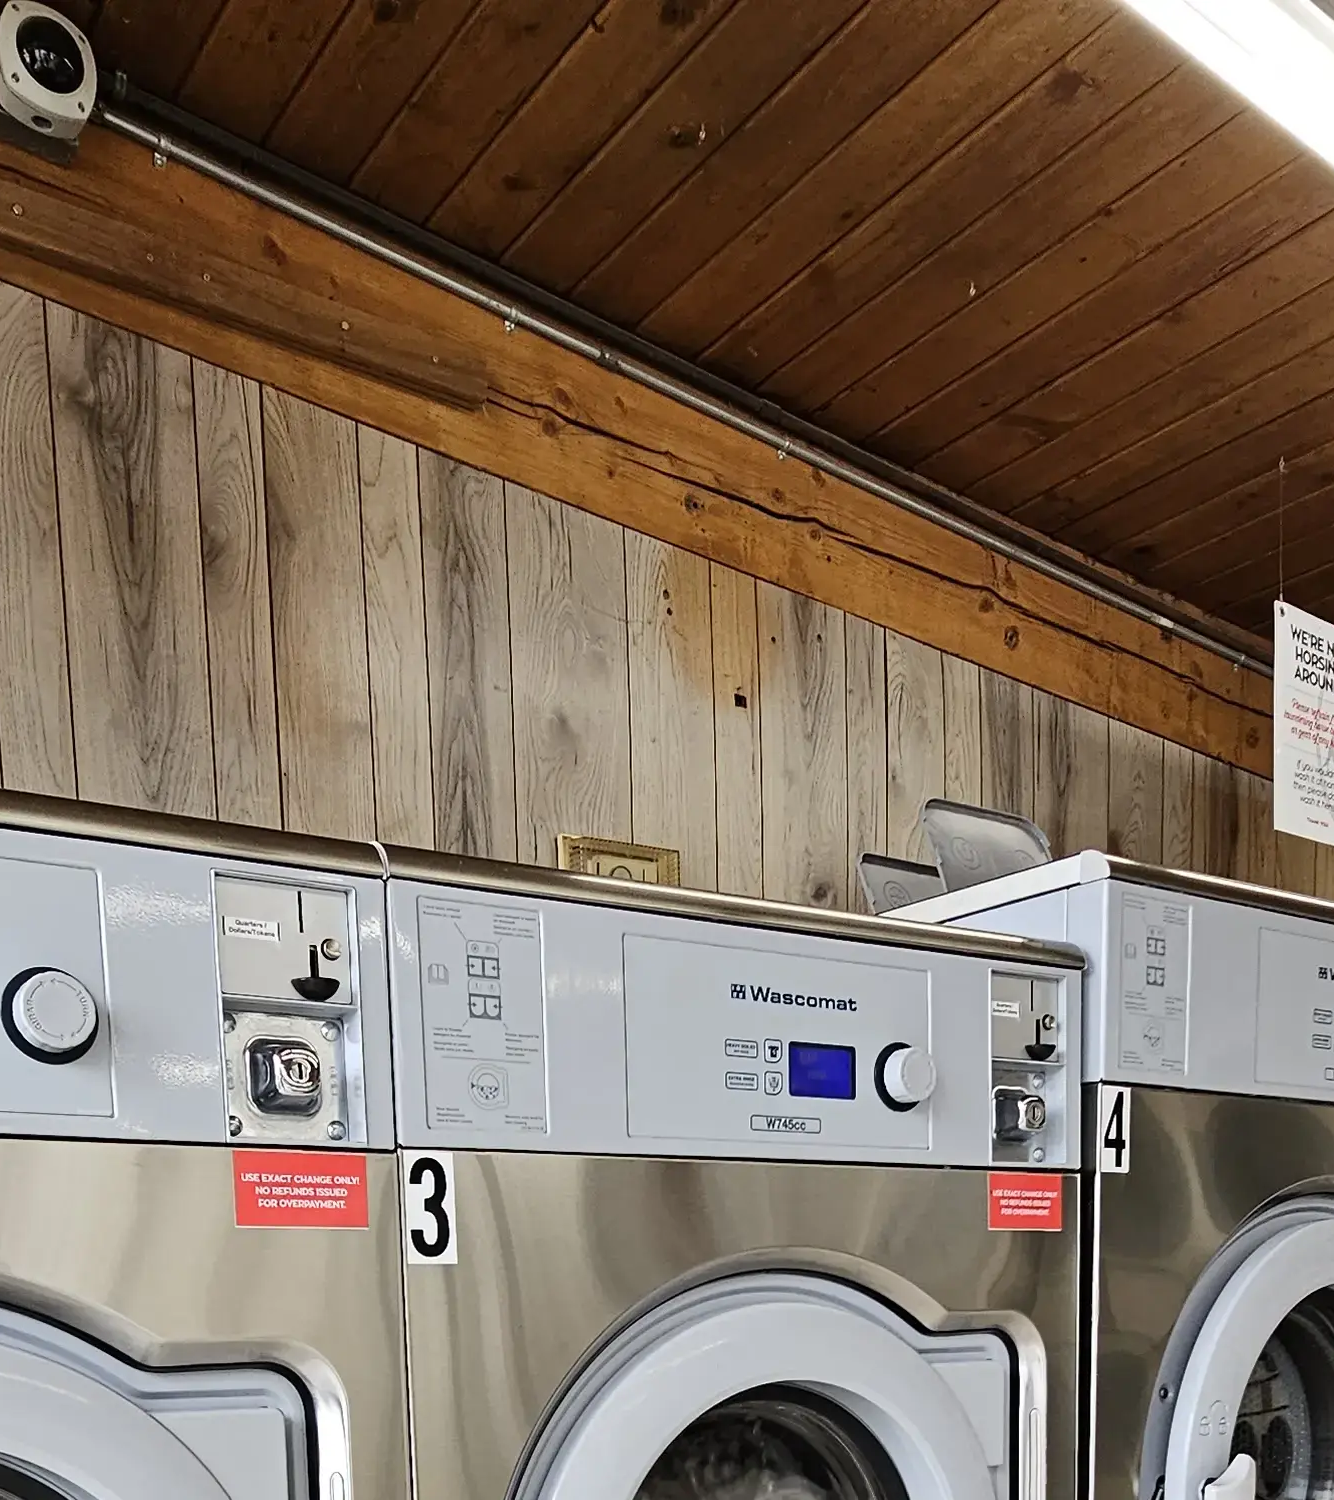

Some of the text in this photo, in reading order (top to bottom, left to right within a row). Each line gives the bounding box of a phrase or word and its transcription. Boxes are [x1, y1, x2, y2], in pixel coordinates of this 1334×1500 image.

[1290, 624, 1324, 653] WE'RE
[234, 919, 263, 928] Quarters
[750, 985, 858, 1012] Wascomat
[766, 1117, 806, 1131] W745cc
[1103, 1091, 1126, 1168] 4
[240, 1172, 360, 1185] USE EXACT CHANGE ONLY!
[255, 1186, 348, 1197] NO REFUNDS ISSUED
[258, 1198, 347, 1209] FOR OVERPAYMENT.
[408, 1157, 450, 1258] 3
